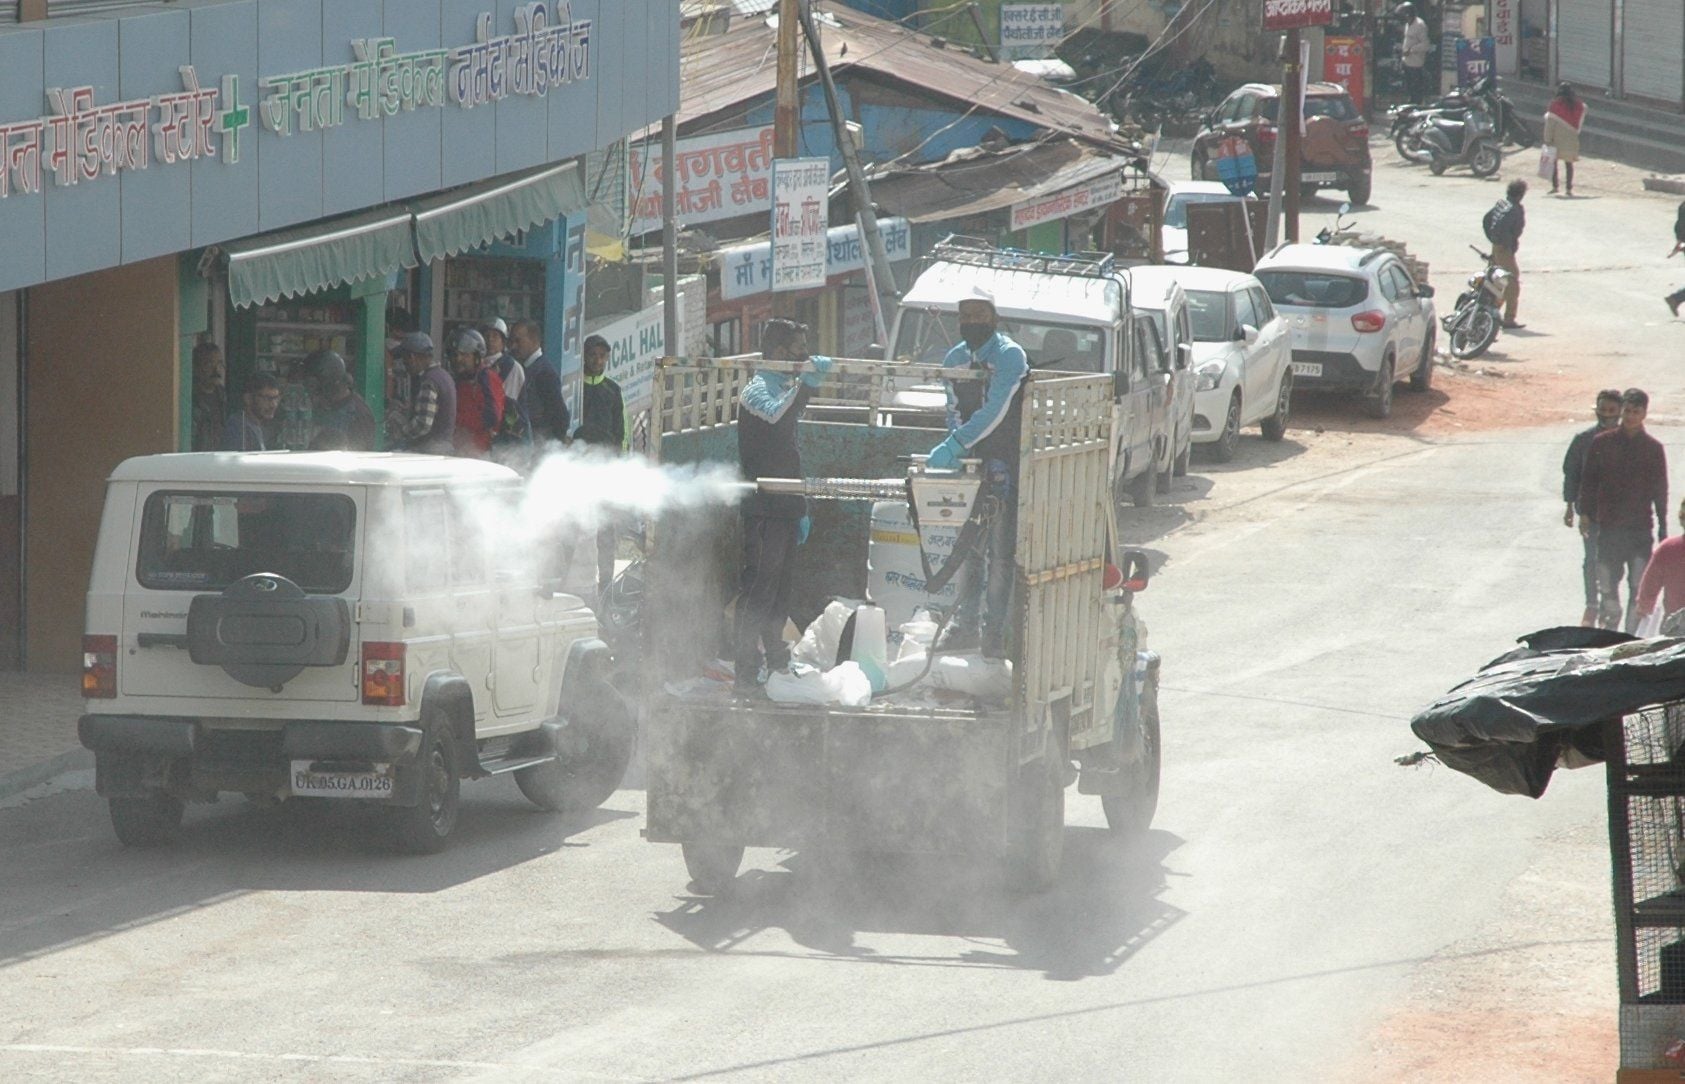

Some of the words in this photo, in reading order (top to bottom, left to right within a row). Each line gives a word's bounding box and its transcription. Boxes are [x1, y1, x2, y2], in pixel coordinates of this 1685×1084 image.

[151, 65, 219, 164] स्टोर
[258, 65, 347, 137] जनता
[450, 11, 512, 109] नर्मदा
[607, 335, 636, 372] ICAL
[640, 322, 664, 356] HAL
